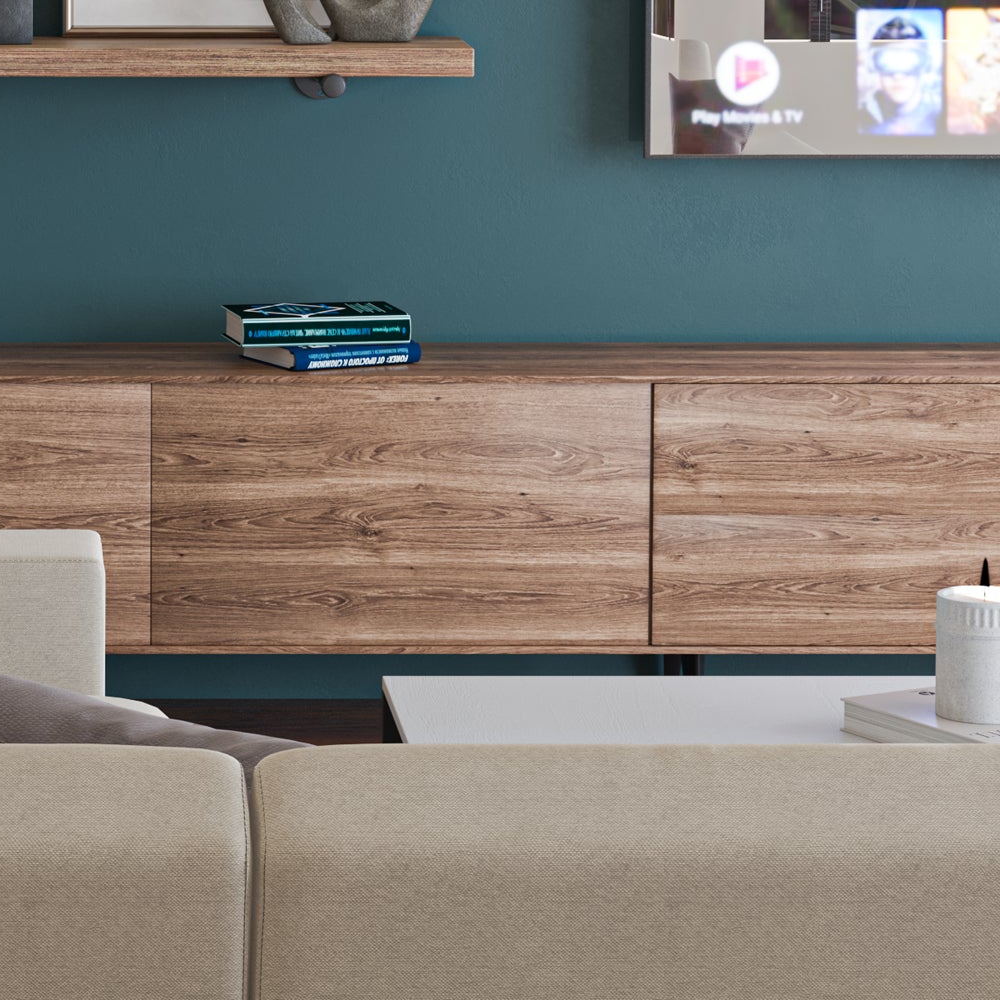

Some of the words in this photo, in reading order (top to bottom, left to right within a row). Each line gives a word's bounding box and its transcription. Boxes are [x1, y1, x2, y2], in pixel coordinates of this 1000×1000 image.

[692, 110, 720, 126] Play
[723, 110, 769, 124] Movies
[772, 110, 781, 124] &
[784, 110, 803, 124] TV
